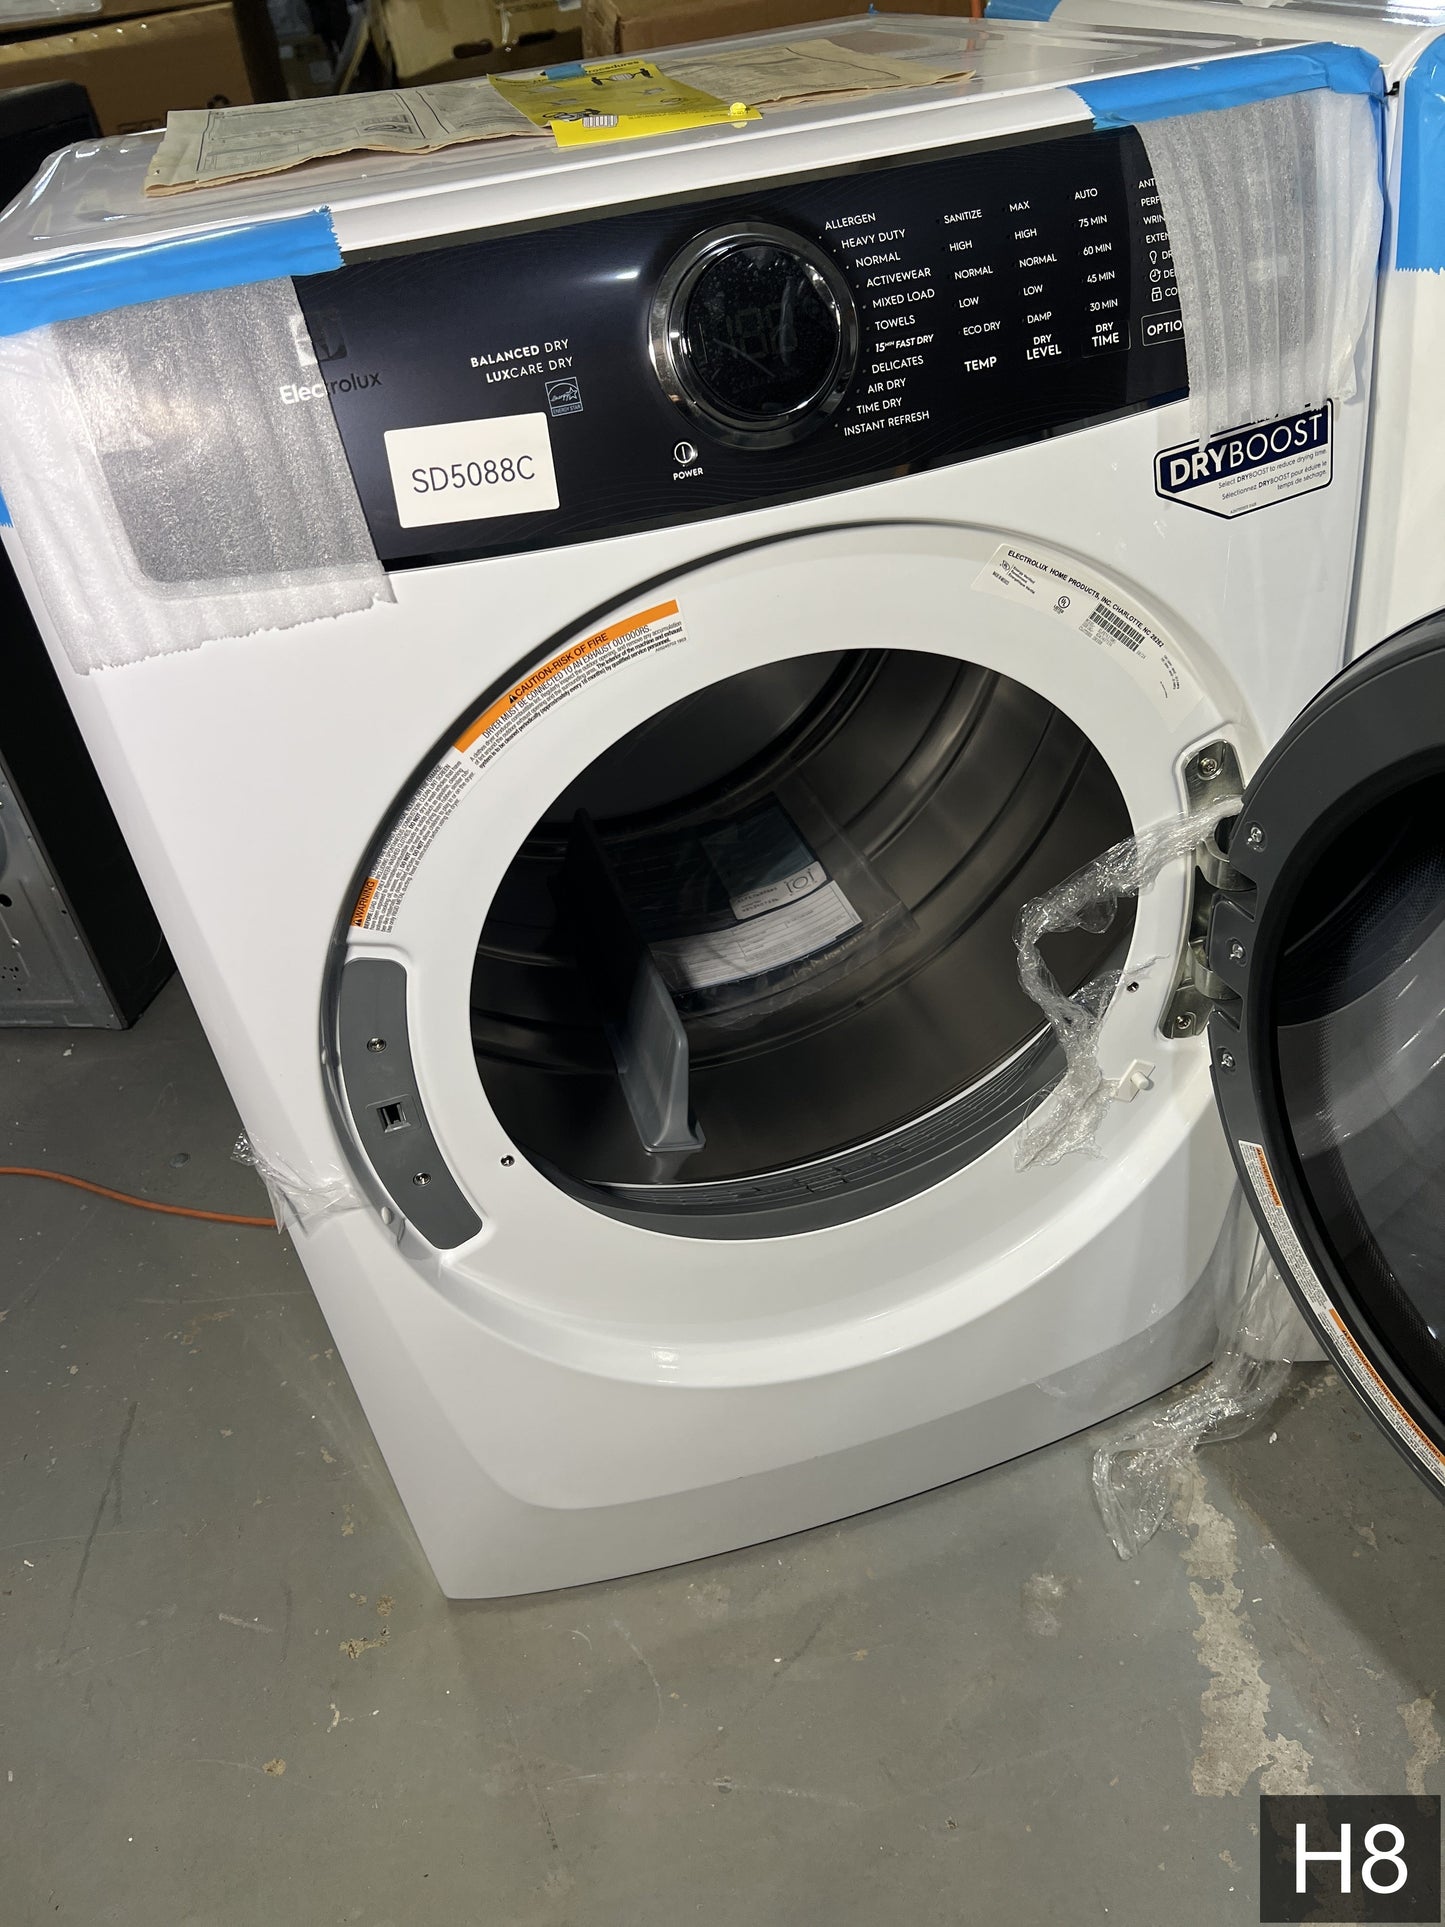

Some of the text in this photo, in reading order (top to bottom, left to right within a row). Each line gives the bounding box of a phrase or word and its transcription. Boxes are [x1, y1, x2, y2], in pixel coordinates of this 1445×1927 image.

[1074, 188, 1098, 200] AUTO
[1009, 200, 1030, 212] MAX
[825, 212, 876, 230] ALLERGEN
[944, 209, 983, 224] SANITIZE
[1078, 214, 1108, 228] 75 MIN
[841, 229, 906, 249] HEAVY DUTY
[1014, 228, 1037, 240] HIGH
[949, 240, 973, 252] HIGH
[1083, 242, 1112, 256] 60 MIN
[855, 252, 901, 268] NORMAL
[1019, 253, 1057, 268] NORMAL
[866, 267, 932, 288] ACTIVEWEAR
[954, 266, 993, 280] NORMAL
[1086, 270, 1115, 283] 45 MIN
[872, 288, 935, 308] MIXED LOAD
[1023, 284, 1043, 296] LOW
[959, 296, 979, 308] LOW
[1089, 298, 1118, 312] 30 MIN
[875, 314, 916, 331] TOWELS
[1027, 311, 1052, 324] DAMP
[963, 321, 1001, 336] ECO DRY
[1095, 322, 1114, 333] DRY
[896, 337, 915, 349] FAST
[916, 334, 934, 345] DRY
[1033, 334, 1052, 346] DRY
[1091, 332, 1120, 348] TIME
[470, 338, 569, 368] BALANCED DRY
[1026, 344, 1062, 360] LEVEL
[486, 356, 573, 383] LUXCARE DRY
[872, 355, 924, 374] DELICATES
[964, 356, 997, 372] TEMP
[867, 378, 906, 394] AIR DRY
[856, 397, 902, 415] TIME DRY
[844, 410, 930, 436] INSTANT REFRESH
[1170, 414, 1322, 487] DRYBOOST
[412, 455, 535, 494] SD5088C
[673, 467, 704, 481] POWER
[1218, 478, 1236, 489] Select
[1237, 467, 1269, 483] DRYBOOST
[1277, 459, 1295, 469] reduce
[1297, 453, 1314, 464] drying
[1258, 472, 1290, 488] DRYBOOST
[1291, 469, 1304, 478] pour
[1277, 480, 1294, 490] temps
[1009, 549, 1048, 572] ELECTROLUX
[1050, 568, 1067, 581] HOME
[1068, 577, 1101, 600] PRODUCTS,
[1143, 627, 1151, 636] NC
[514, 632, 608, 698] CAUTION-RISK OF FIRE
[483, 717, 505, 739] DRYER
[500, 704, 519, 722] MUST
[517, 697, 528, 708] BE
[525, 670, 564, 701] CONNECTED
[562, 664, 573, 675] TO
[571, 658, 583, 669] AN
[581, 642, 612, 663] EXHAUST
[408, 821, 416, 829] DO
[412, 812, 421, 823] NOT
[413, 840, 424, 857] DO NOT
[403, 852, 411, 862] NOT
[356, 880, 375, 921] WARNING
